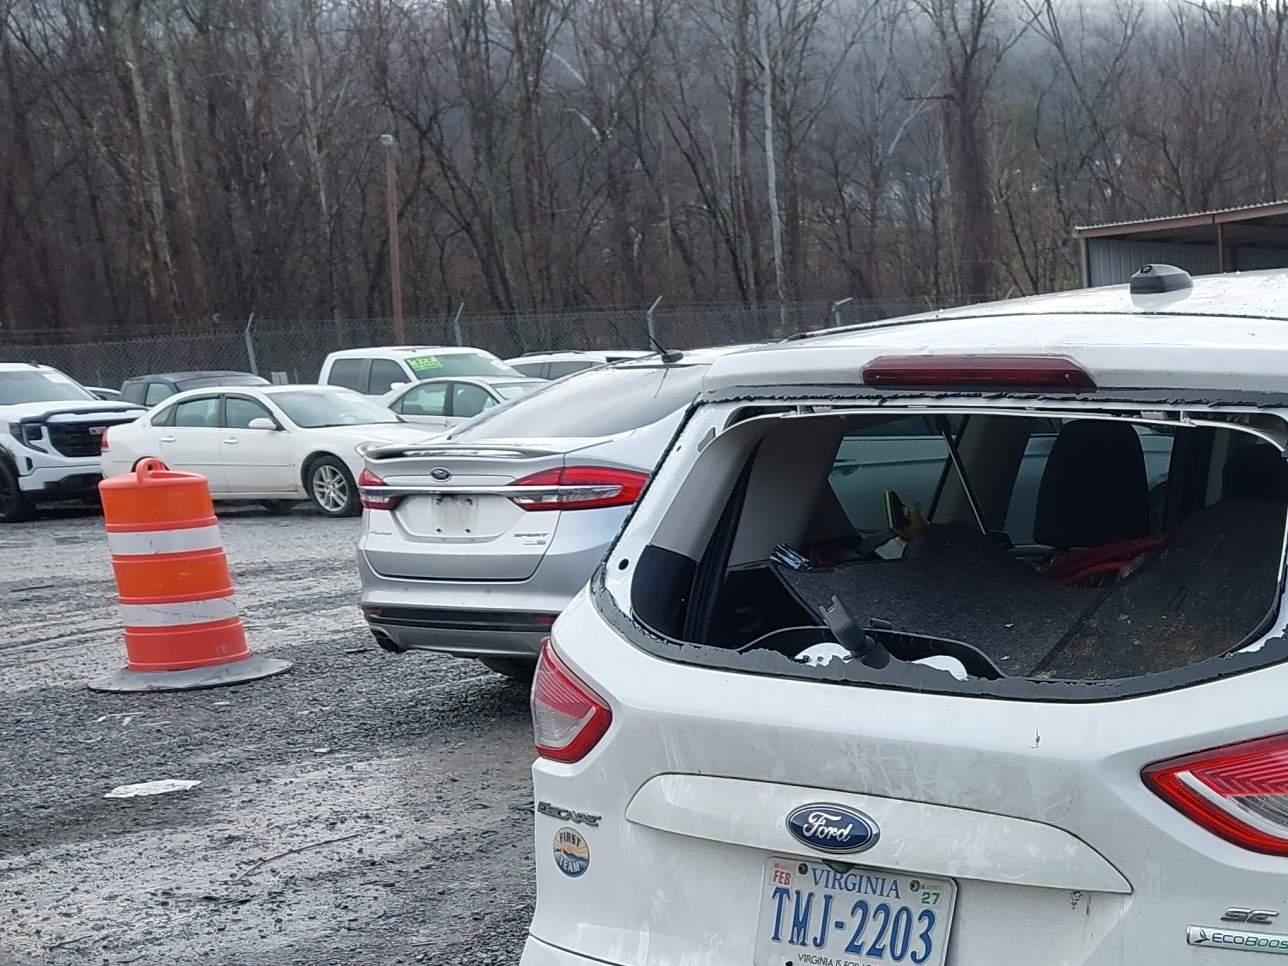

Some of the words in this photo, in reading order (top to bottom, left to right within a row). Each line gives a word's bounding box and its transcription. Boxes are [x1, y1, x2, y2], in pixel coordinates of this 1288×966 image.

[803, 810, 853, 842] Ford
[559, 831, 582, 848] FIRST
[559, 856, 581, 873] TEAM
[773, 869, 791, 886] FEB
[811, 867, 902, 900] VIRGINIA
[921, 891, 941, 905] 27
[1220, 906, 1280, 925] SE
[771, 886, 936, 966] TMJ-2203
